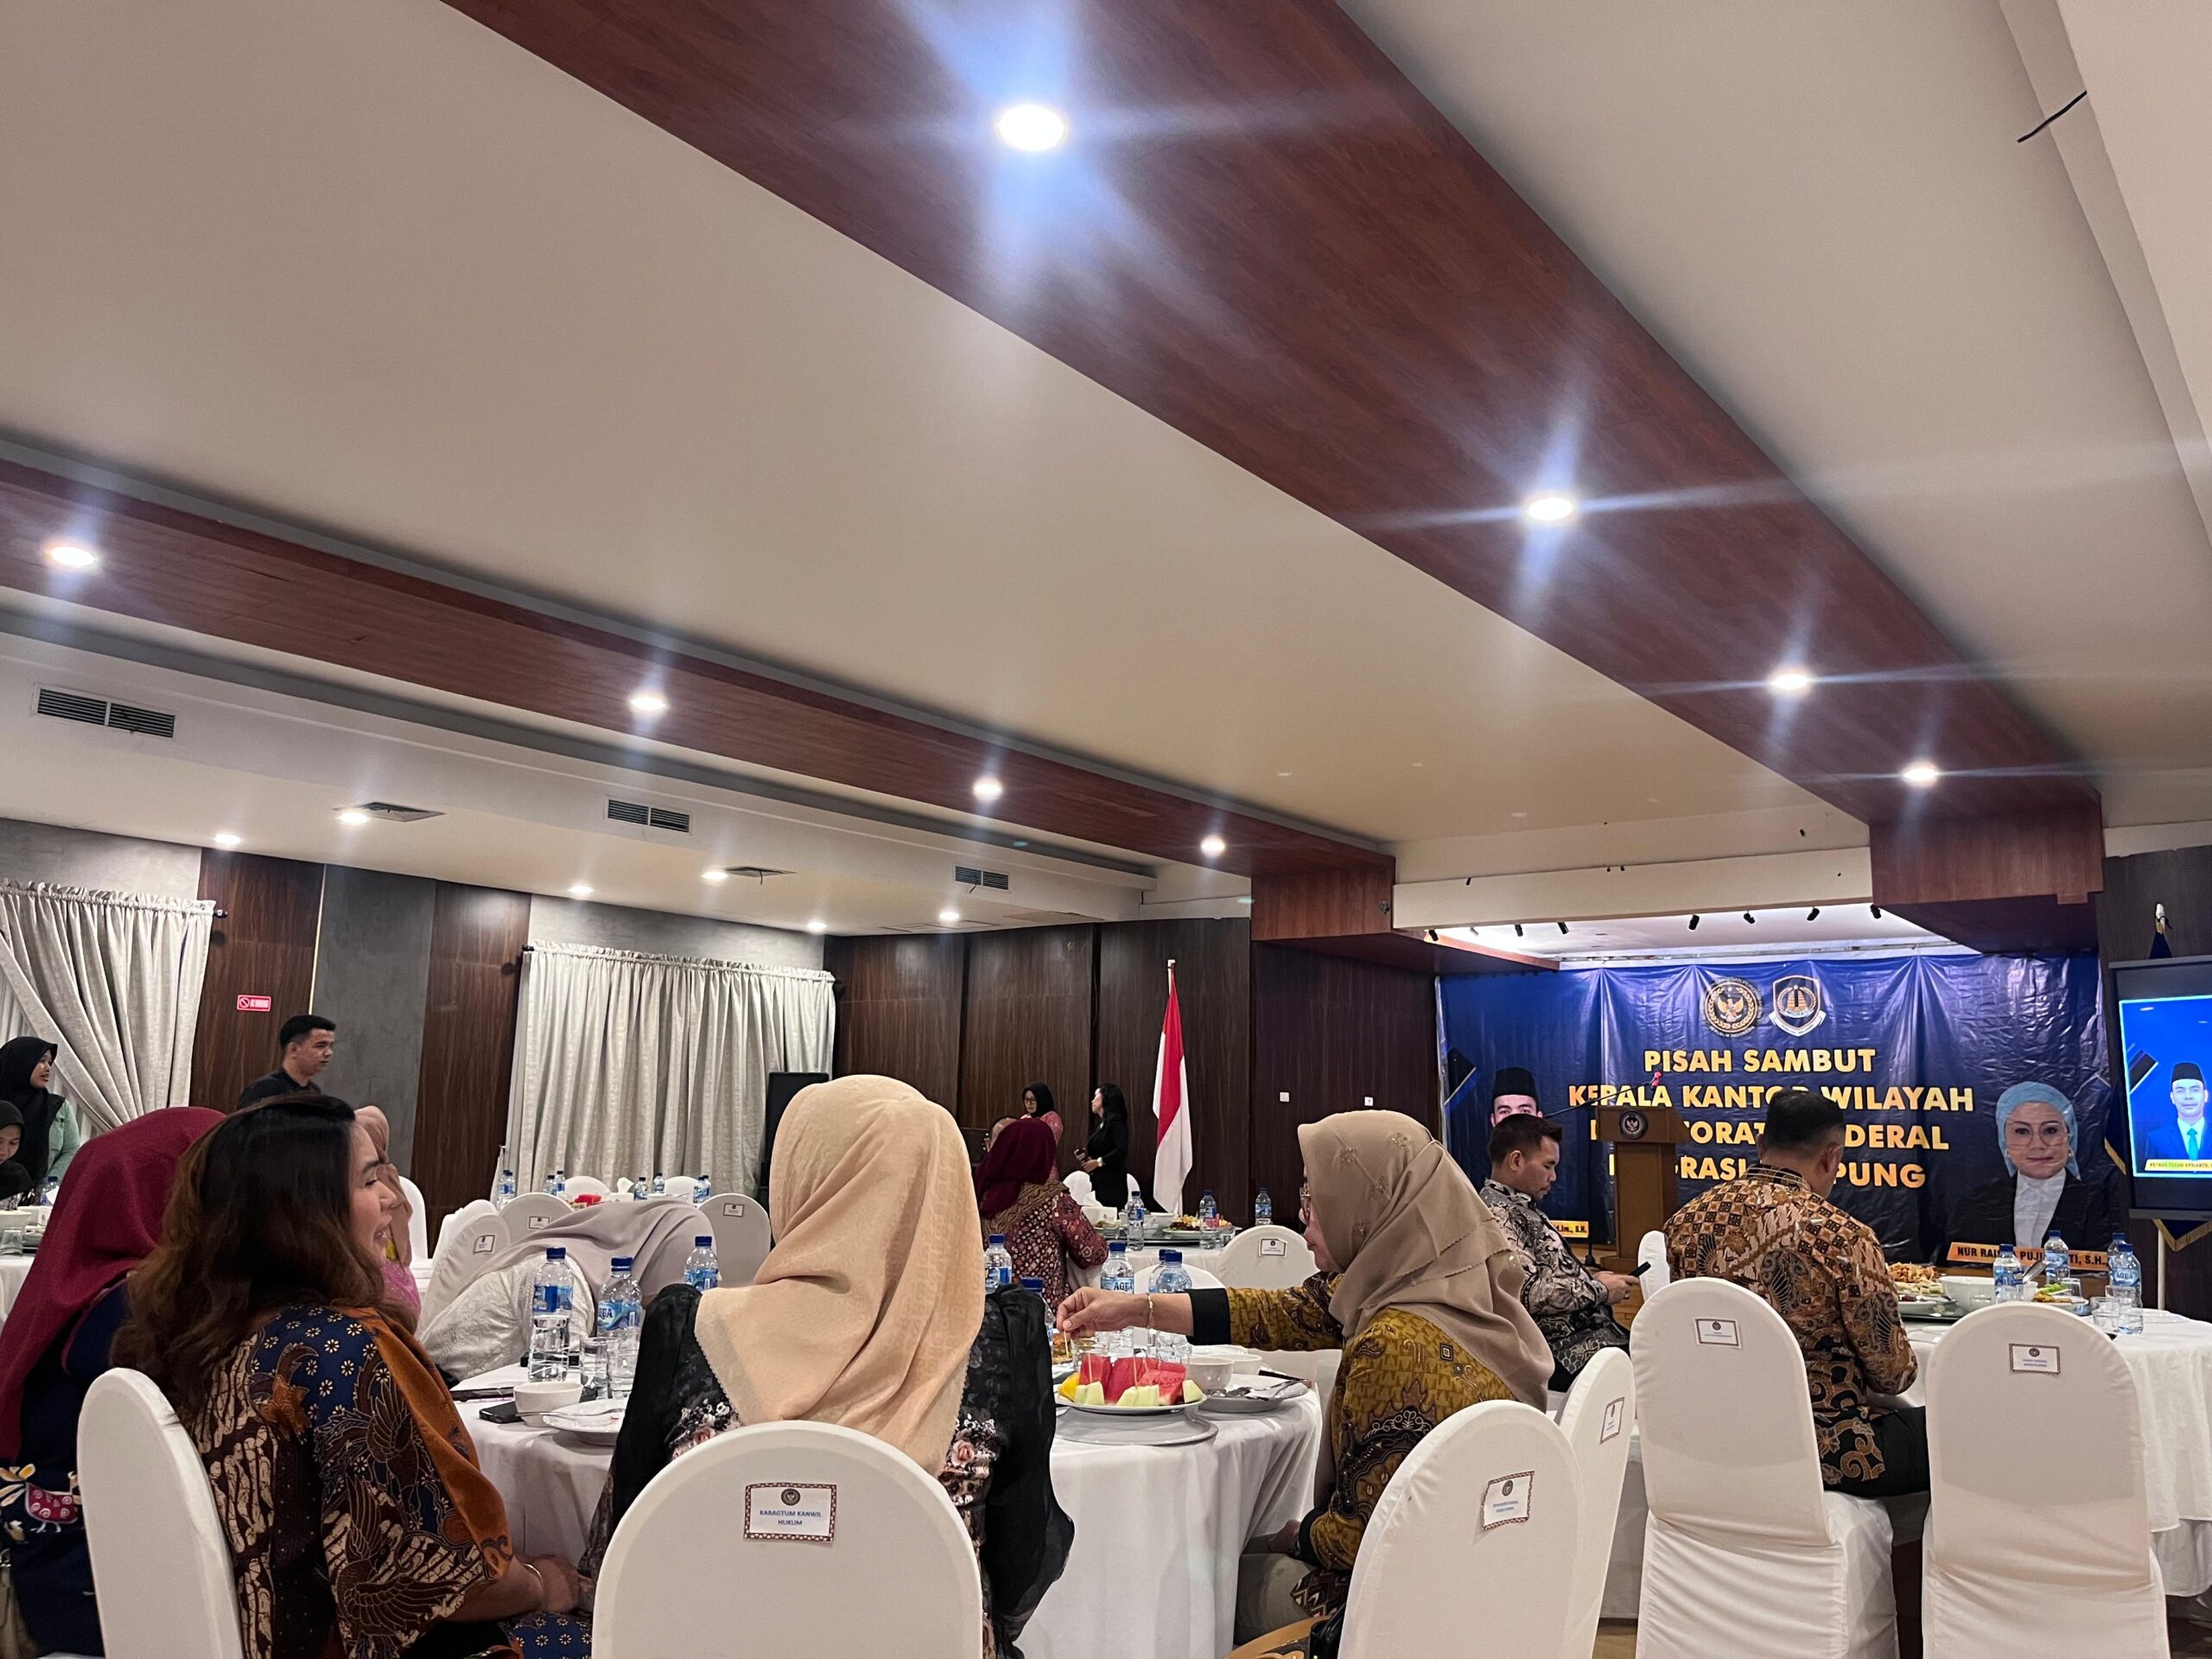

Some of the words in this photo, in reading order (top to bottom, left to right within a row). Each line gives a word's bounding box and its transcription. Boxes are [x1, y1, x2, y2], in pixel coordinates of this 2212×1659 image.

[1644, 1050, 1732, 1072] PISAH
[1743, 1049, 1876, 1072] SAMBUT
[1568, 1085, 1673, 1107] KEPALA
[1682, 1085, 1809, 1108] KANT
[1821, 1086, 1974, 1111] WILAYAH
[1845, 1124, 1949, 1150] DERAL
[1834, 1162, 1925, 1188] PUNG
[1957, 1247, 1977, 1256] NUR
[1114, 1281, 1133, 1292] AQUA
[598, 1307, 613, 1319] QUA
